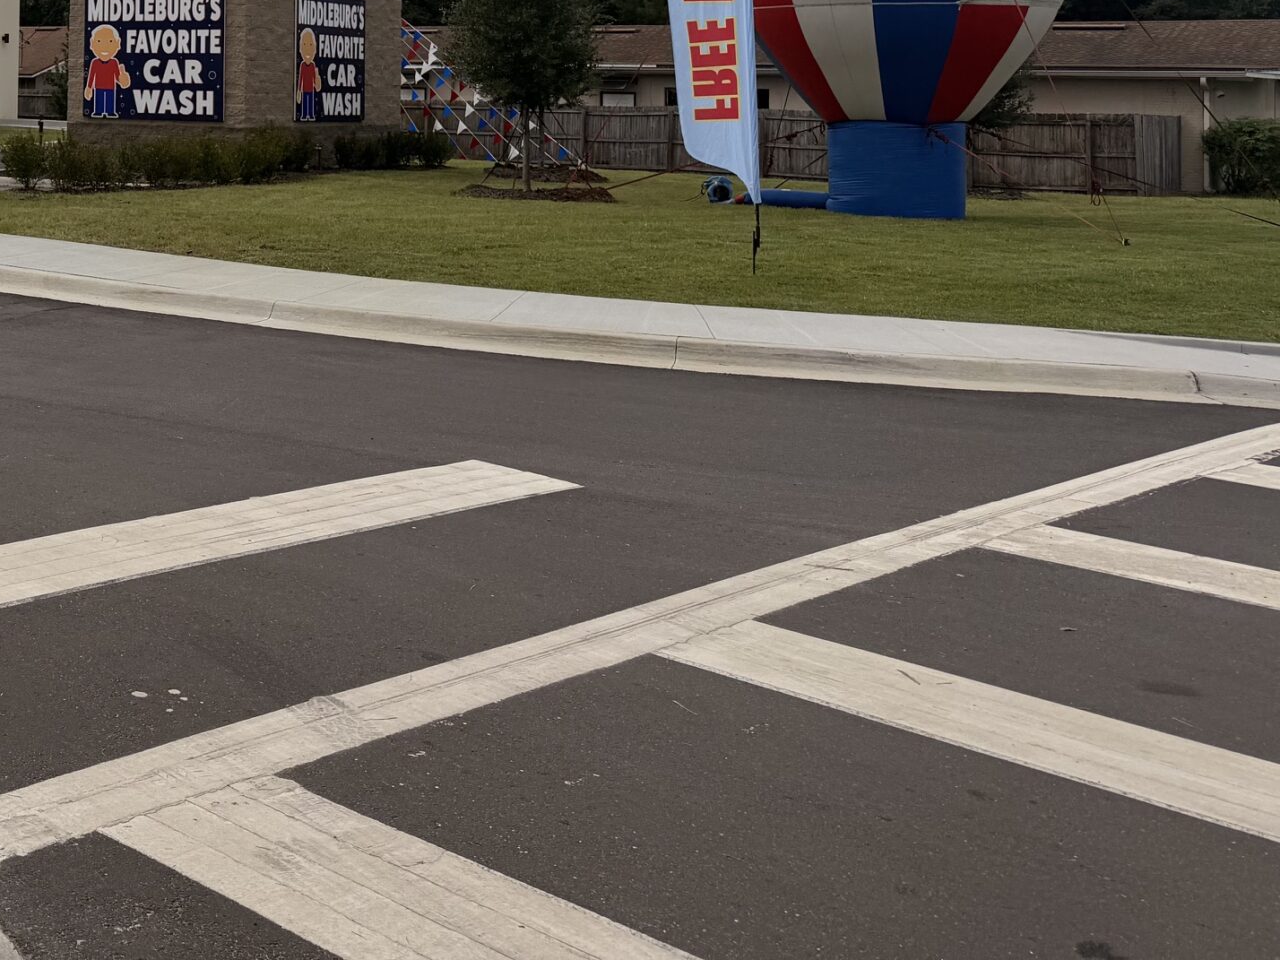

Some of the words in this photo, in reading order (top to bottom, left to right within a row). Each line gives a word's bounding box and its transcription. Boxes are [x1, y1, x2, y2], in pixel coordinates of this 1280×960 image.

[298, 0, 364, 30] MIDDLEBURG'S
[126, 28, 222, 54] FAVORITE
[319, 34, 364, 60] FAVORITE
[142, 58, 203, 84] CAR
[327, 62, 356, 87] CAR
[132, 89, 214, 115] WASH
[322, 92, 361, 116] WASH
